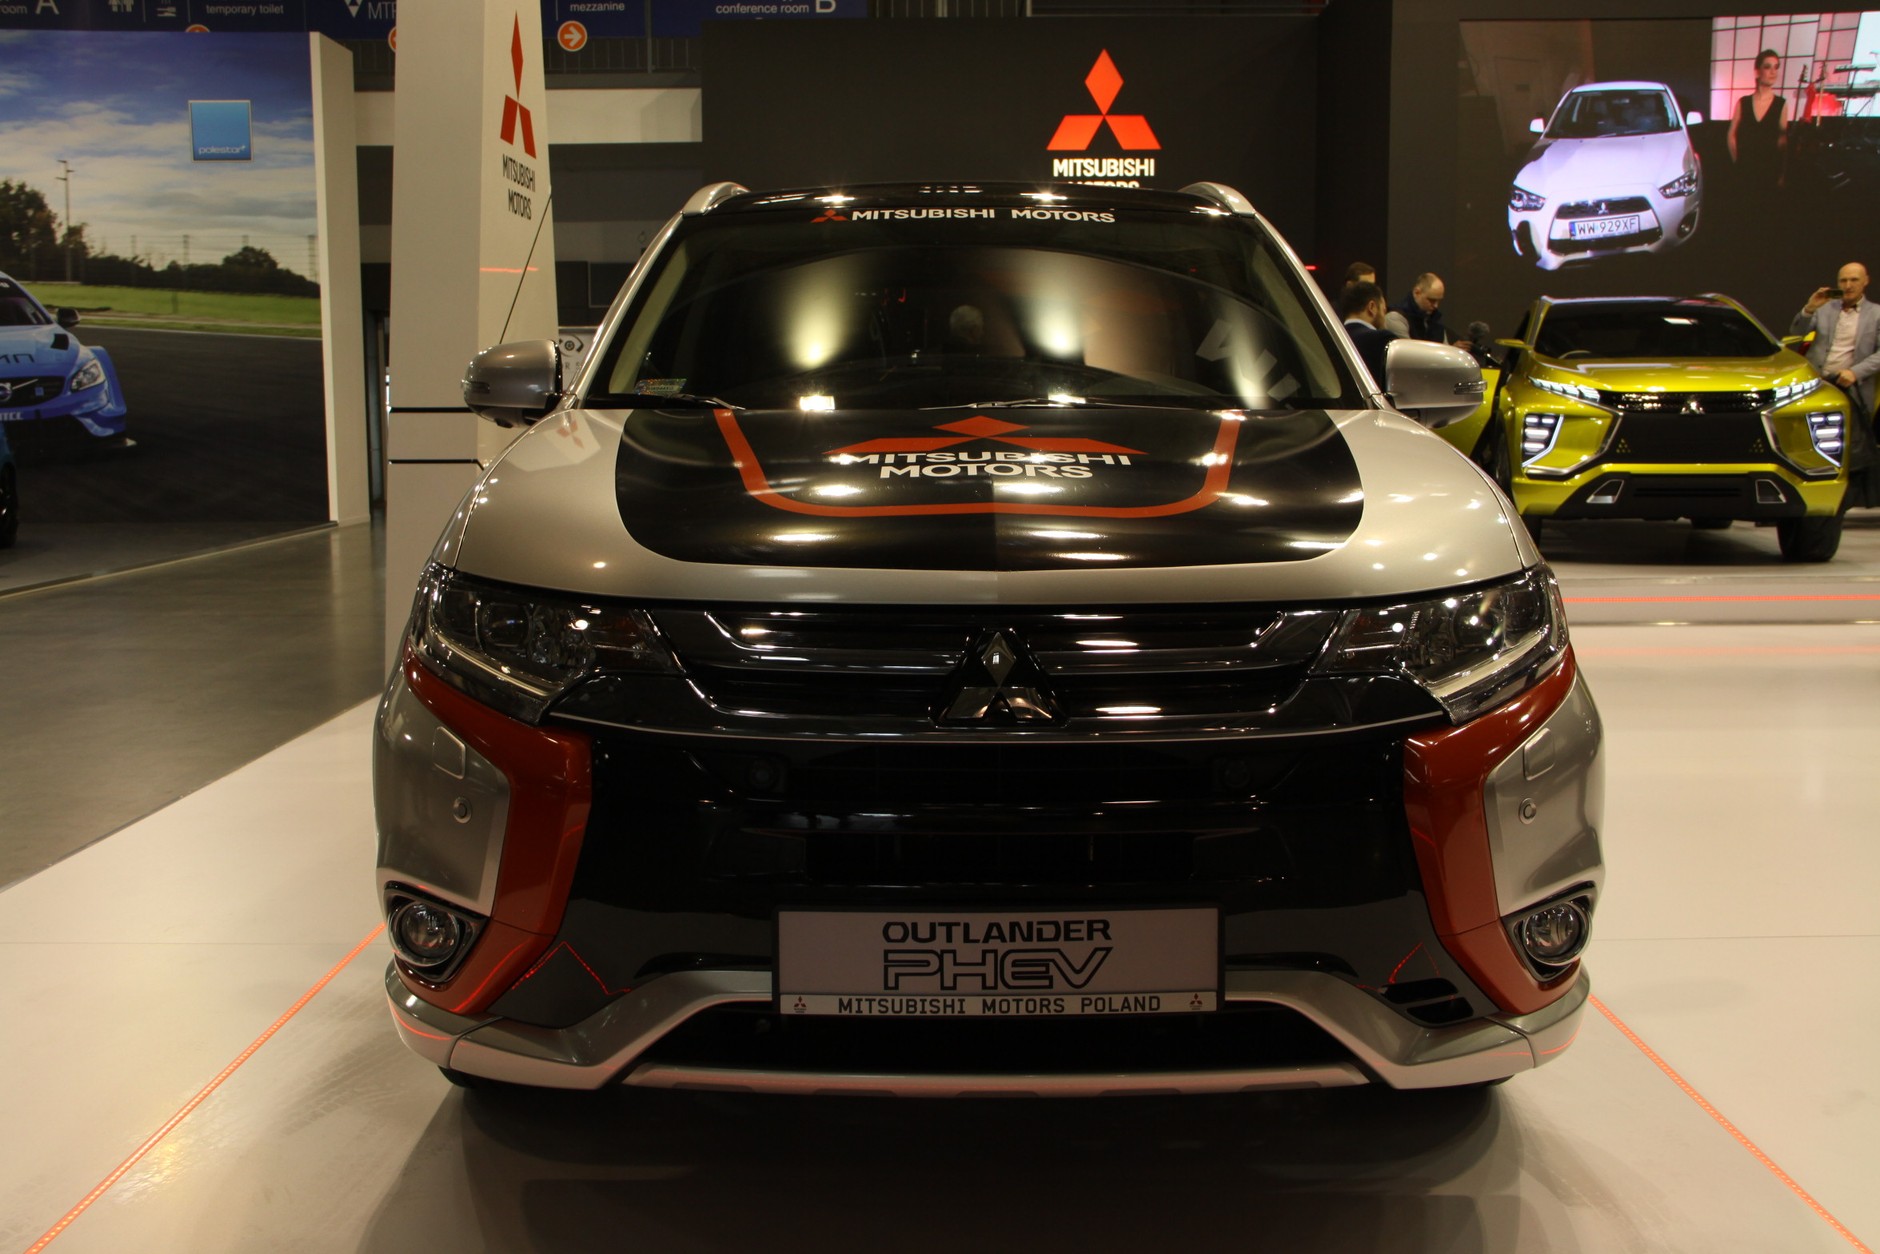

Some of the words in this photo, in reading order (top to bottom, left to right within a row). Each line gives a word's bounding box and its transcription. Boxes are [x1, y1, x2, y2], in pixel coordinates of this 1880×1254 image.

[206, 4, 256, 15] temporary
[260, 4, 284, 14] toilet
[570, 2, 625, 12] mezzanine
[715, 3, 777, 13] conference
[780, 4, 809, 13] room
[502, 153, 536, 193] MITSUBISHI
[1053, 158, 1155, 177] MITSUBISHI
[508, 188, 532, 221] MOTORS
[851, 208, 995, 221] MITSUBISHI
[1011, 209, 1116, 223] MOTORS
[1577, 222, 1596, 235] WW
[1600, 217, 1637, 234] 929XF
[879, 463, 1093, 479] MOTORS
[882, 919, 1113, 943] OUTLANDER
[883, 947, 1114, 991] PHEV
[838, 997, 966, 1015] MITSUBISHI
[981, 996, 1066, 1014] MOTORS
[1080, 995, 1162, 1013] POLAND
